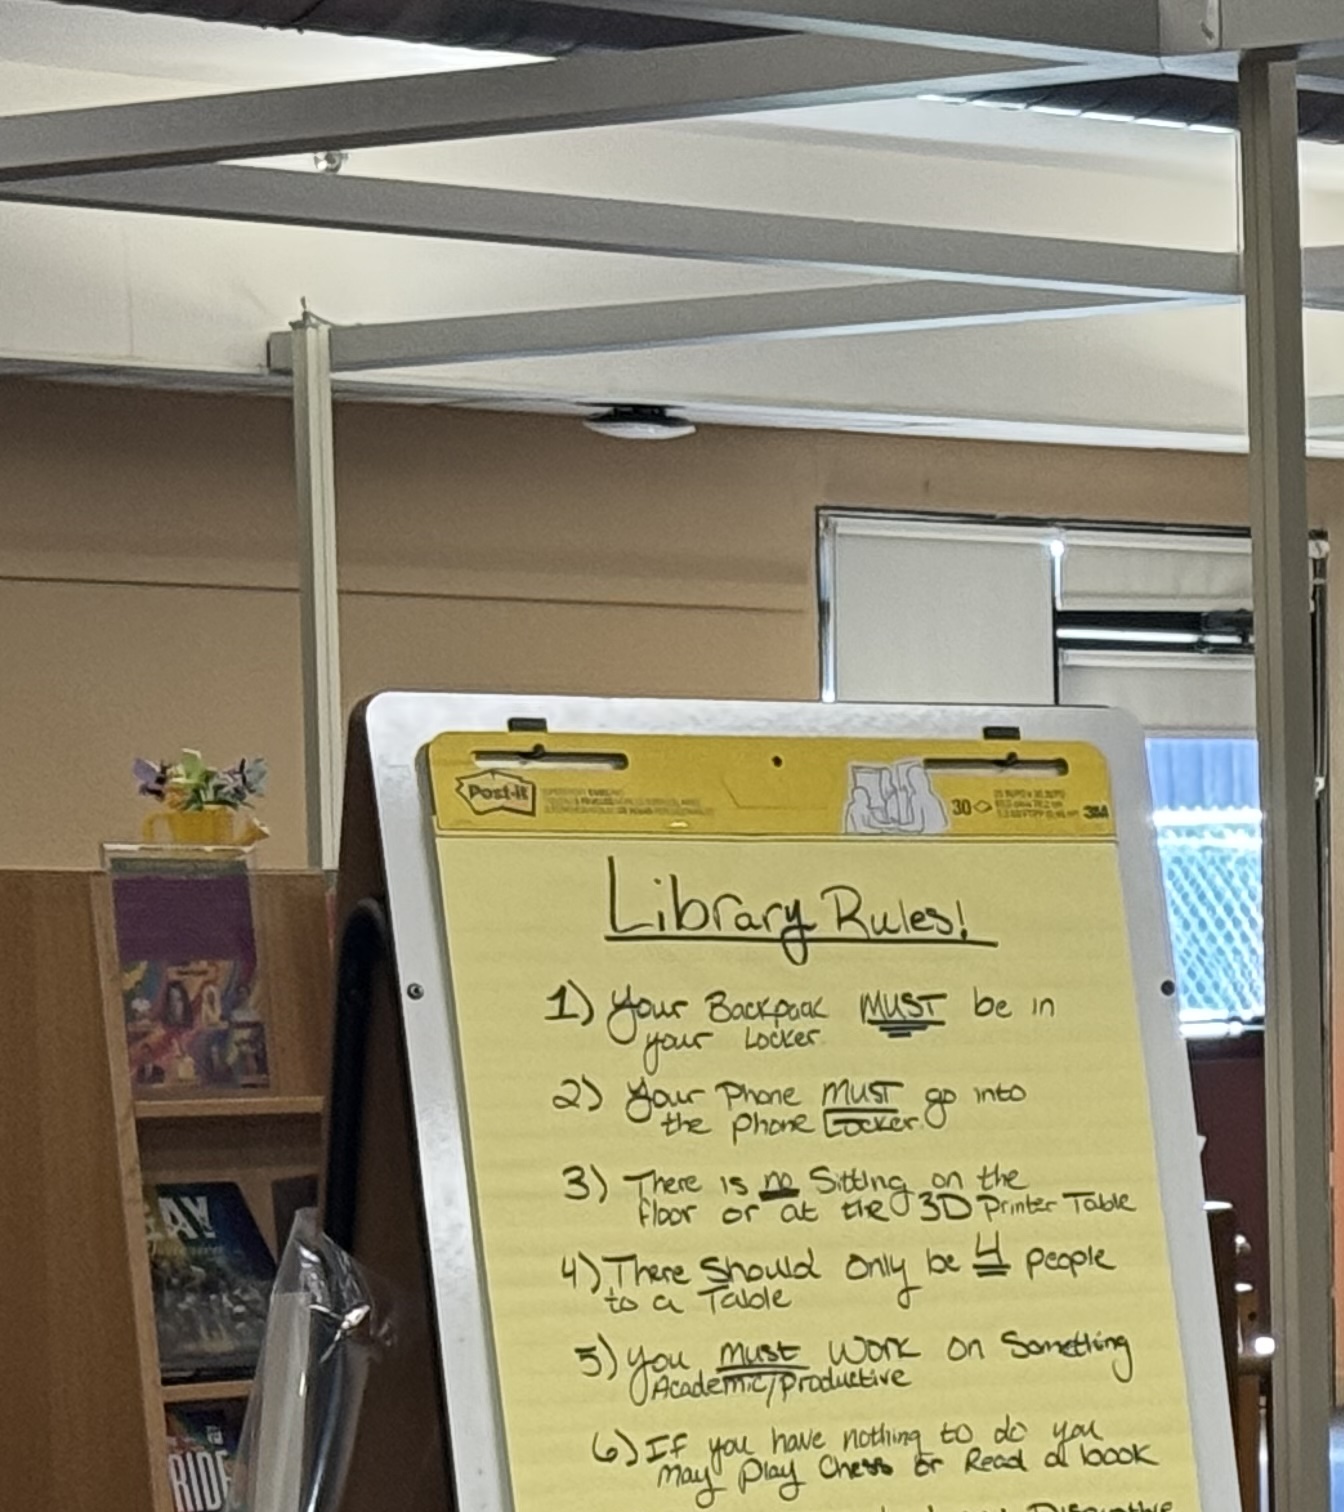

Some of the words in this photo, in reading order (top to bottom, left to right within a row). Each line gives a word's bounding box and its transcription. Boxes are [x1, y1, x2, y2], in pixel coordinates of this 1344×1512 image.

[468, 784, 529, 801] Post-it
[952, 798, 972, 816] 30
[607, 856, 818, 964] Library
[821, 884, 968, 940] Rules!
[545, 979, 594, 1026] 1)
[859, 988, 948, 1024] MUST
[974, 986, 1013, 1018] be
[1032, 994, 1056, 1017] in
[552, 1073, 603, 1112] 2)
[821, 1078, 905, 1107] MUST
[924, 1087, 958, 1129] go
[974, 1083, 1028, 1105] into
[661, 1111, 713, 1137] the
[562, 1163, 608, 1204] 3)
[622, 1168, 703, 1200] There
[719, 1175, 749, 1197] is
[763, 1169, 794, 1190] no
[931, 1169, 965, 1191] on
[976, 1161, 1030, 1192] the
[720, 1202, 761, 1225] or
[779, 1200, 820, 1223] at
[841, 1199, 891, 1223] the
[918, 1190, 974, 1223] 3D
[560, 1250, 602, 1295] 4)
[601, 1252, 692, 1288] There
[926, 1248, 961, 1277] be
[974, 1229, 1004, 1267] 4
[603, 1286, 640, 1315] to
[651, 1293, 686, 1315] a
[574, 1332, 618, 1382] 5)
[591, 1427, 639, 1468] 6)
[644, 1432, 689, 1464] If
[708, 1435, 756, 1476] you
[771, 1426, 827, 1455] have
[843, 1421, 934, 1457] nothing
[940, 1422, 974, 1445] to
[994, 1413, 1028, 1445] do
[1052, 1418, 1105, 1452] you
